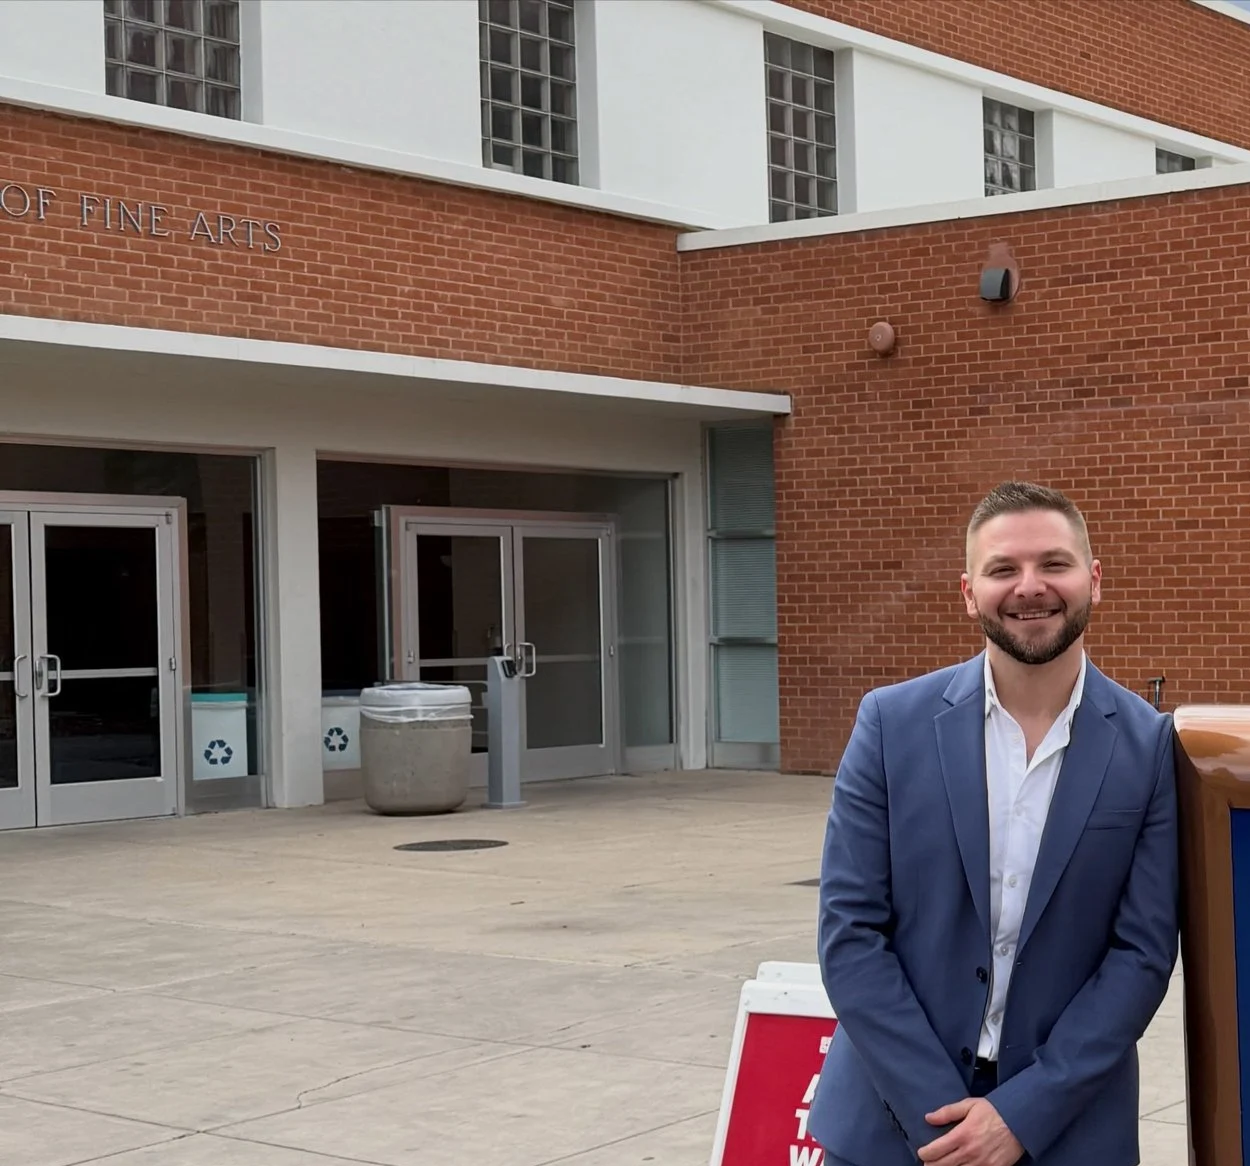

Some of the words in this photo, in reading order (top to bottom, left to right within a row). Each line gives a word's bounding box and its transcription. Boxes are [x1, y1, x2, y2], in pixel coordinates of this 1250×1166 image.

[1, 184, 57, 220] OF
[80, 194, 170, 238] FINE
[190, 211, 282, 252] ARTS
